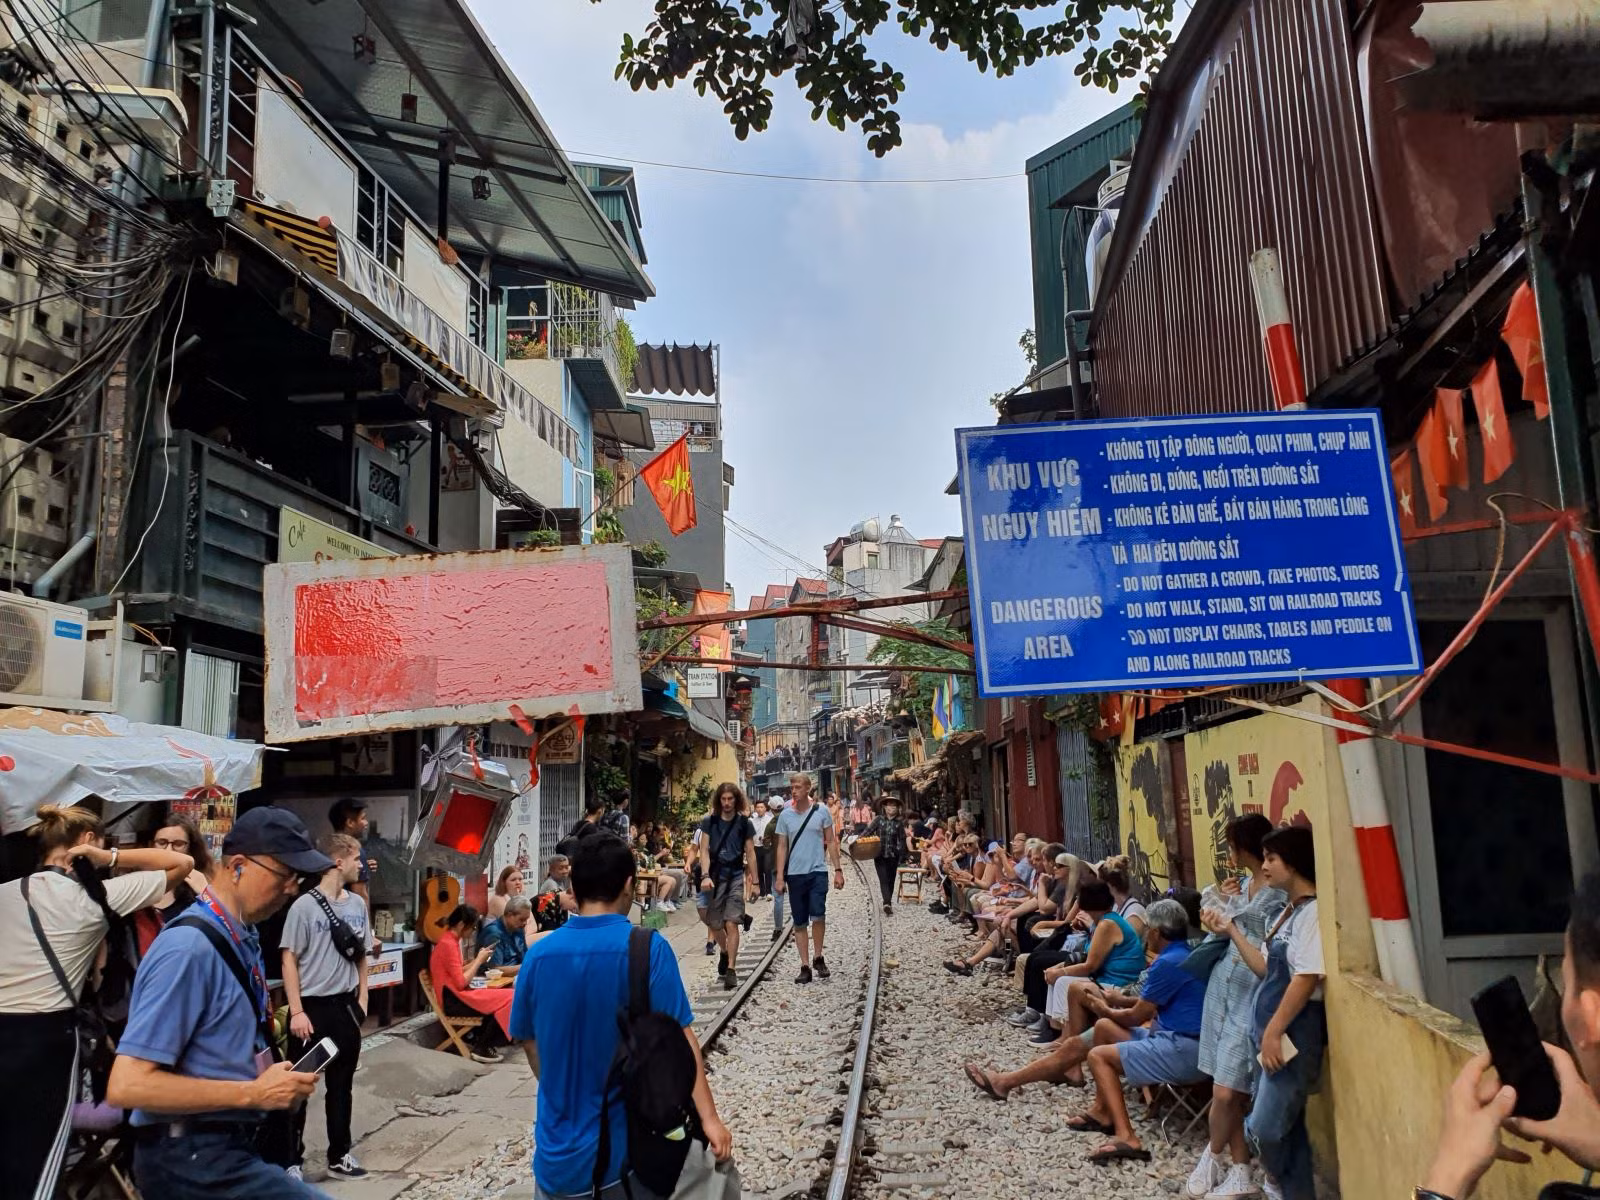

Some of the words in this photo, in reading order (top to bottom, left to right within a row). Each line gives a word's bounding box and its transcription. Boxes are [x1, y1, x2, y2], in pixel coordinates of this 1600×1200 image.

[1106, 437, 1144, 461] KHÔNG
[1145, 440, 1160, 462] TỤ
[1162, 435, 1182, 462] TẬP
[1185, 434, 1215, 456] ĐÔNG
[1217, 430, 1254, 456] NGƯỜI,
[1255, 434, 1282, 455] QUAY
[1285, 433, 1317, 453] PHIM,
[1318, 432, 1345, 454] CHỤP
[1348, 424, 1371, 450] ẢNH
[987, 462, 1031, 491] KHU
[1037, 458, 1080, 493] VỰC
[1110, 470, 1148, 494] KHÔNG
[1150, 473, 1166, 493] ĐI,
[1167, 466, 1201, 491] ĐỨNG,
[1231, 464, 1259, 487] TRÊN
[1261, 462, 1298, 486] ĐƯỜNG
[1300, 459, 1320, 484] SẮT
[982, 512, 1038, 541] NGUY
[1047, 497, 1102, 537] HIỂM
[1114, 504, 1153, 527] KHÔNG
[1154, 502, 1169, 525] KÊ
[1171, 500, 1195, 524] BÀN
[1197, 496, 1222, 523] GHẾ,
[1247, 497, 1271, 520] BÁN
[1272, 496, 1302, 519] HÀNG
[1303, 497, 1340, 517] TRONG
[1340, 492, 1369, 516] LÒNG
[326, 536, 352, 553] WELCOME
[353, 547, 360, 556] TO
[1112, 541, 1128, 564] VÀ
[1132, 544, 1152, 563] HAI
[1154, 539, 1178, 562] BÊN
[1179, 536, 1217, 561] ĐƯỜNG
[1219, 533, 1239, 559] SẮT
[1123, 577, 1138, 592] DO
[1141, 575, 1162, 591] NOT
[1166, 573, 1208, 589] GATHER
[1211, 572, 1219, 587] A
[1221, 570, 1265, 586] CROWD,
[1268, 568, 1294, 584] TAKE
[1295, 566, 1340, 582] PHOTOS,
[1341, 565, 1380, 580] VIDEOS
[991, 596, 1102, 623] DANGEROUS
[1127, 603, 1142, 618] DO
[1145, 602, 1166, 617] NOT
[1169, 600, 1206, 616] WALK,
[1208, 598, 1247, 614] STAND,
[1250, 596, 1266, 611] SIT
[1269, 595, 1285, 611] ON
[1287, 593, 1338, 610] RAILROAD
[1340, 590, 1382, 607] TRACKS
[1128, 630, 1146, 645] DO
[1147, 628, 1170, 644] NOT
[1173, 626, 1218, 643] DISPLAY
[1222, 623, 1266, 640] CHAIRS,
[1267, 621, 1308, 638] TABLES
[1311, 620, 1333, 635] AND
[1335, 618, 1375, 634] PEDDLE
[1376, 617, 1392, 632] ON
[1024, 635, 1074, 660] AREA
[1128, 657, 1150, 672] AND
[1154, 654, 1190, 671] ALONG
[1192, 651, 1246, 669] RAILROAD
[1248, 649, 1291, 666] TRACKS
[688, 672, 700, 680] TRAIN
[700, 672, 718, 680] STATION
